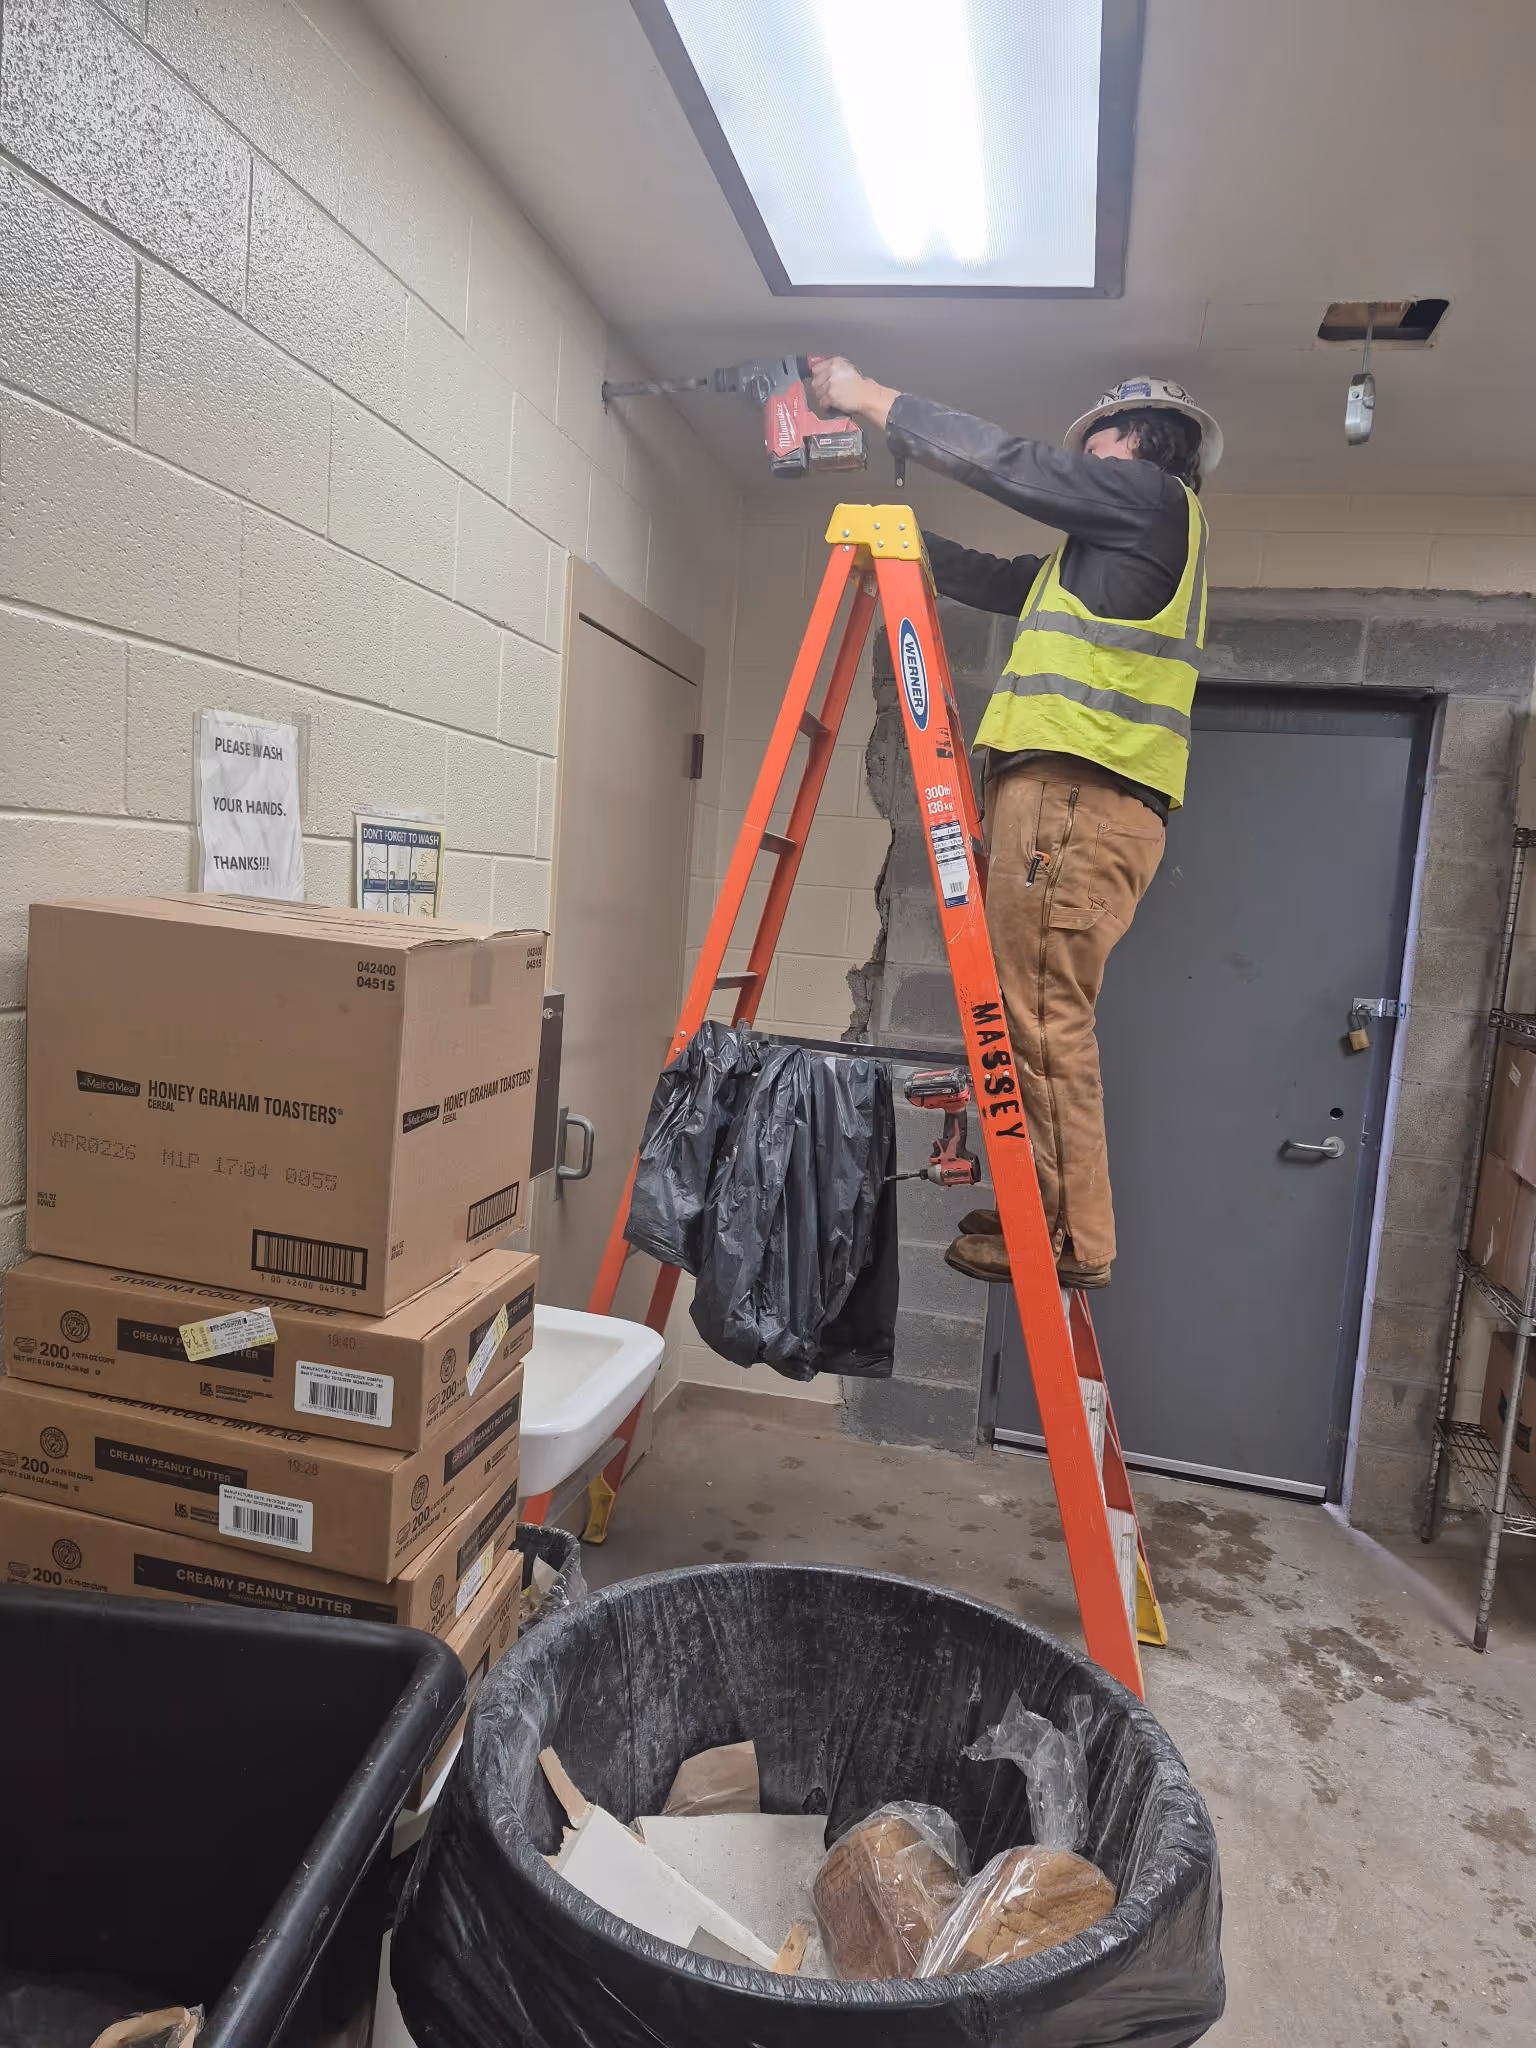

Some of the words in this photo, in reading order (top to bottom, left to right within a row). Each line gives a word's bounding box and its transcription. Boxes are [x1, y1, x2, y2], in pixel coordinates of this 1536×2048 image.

[776, 401, 791, 449] Milwaukee
[904, 641, 924, 708] WERNER
[215, 737, 251, 756] PLEASE
[253, 744, 283, 761] WASH
[213, 796, 242, 813] YOUR
[245, 800, 287, 816] HANDS.
[928, 801, 944, 814] 136
[363, 828, 383, 840] DON'T
[384, 830, 407, 843] FORGET
[408, 832, 418, 844] TO
[418, 833, 440, 846] WASH
[213, 855, 270, 870] THANKS!!!
[526, 946, 543, 957] 042400
[357, 961, 396, 976] 042400
[526, 959, 542, 970] 04515
[356, 976, 396, 992] 04515
[147, 1099, 176, 1112] CEREAL
[148, 1080, 195, 1103] HONEY
[199, 1088, 260, 1113] GRAHAM
[443, 1090, 468, 1113] HONEY
[469, 1080, 498, 1105] GRAHAM
[442, 1112, 457, 1125] CEREAL
[51, 1130, 137, 1161] APR0226
[212, 1156, 269, 1180] 17:04
[271, 1275, 281, 1284] 00
[287, 1277, 314, 1290] 42400
[319, 1283, 346, 1295] 04515
[351, 1289, 357, 1297] 8
[110, 1275, 165, 1290] STORE
[163, 1283, 183, 1294] IN
[180, 1286, 195, 1295] A
[248, 1296, 286, 1310] DRY
[281, 1302, 343, 1318] PLACE
[132, 1330, 173, 1346] CREAMY
[40, 1342, 69, 1360] 200
[440, 1381, 457, 1406] 200
[220, 1416, 260, 1432] DRY
[255, 1424, 314, 1443] PLACE
[21, 1456, 49, 1475] 200
[109, 1449, 150, 1465] CREAMY
[151, 1458, 191, 1476] PEANUT
[192, 1467, 232, 1484] BUTTER
[411, 1505, 430, 1534] 200
[33, 1567, 62, 1586] 200
[176, 1568, 234, 1591] CREAMY
[237, 1580, 294, 1602] PEANUT
[296, 1593, 352, 1615] BUTTER
